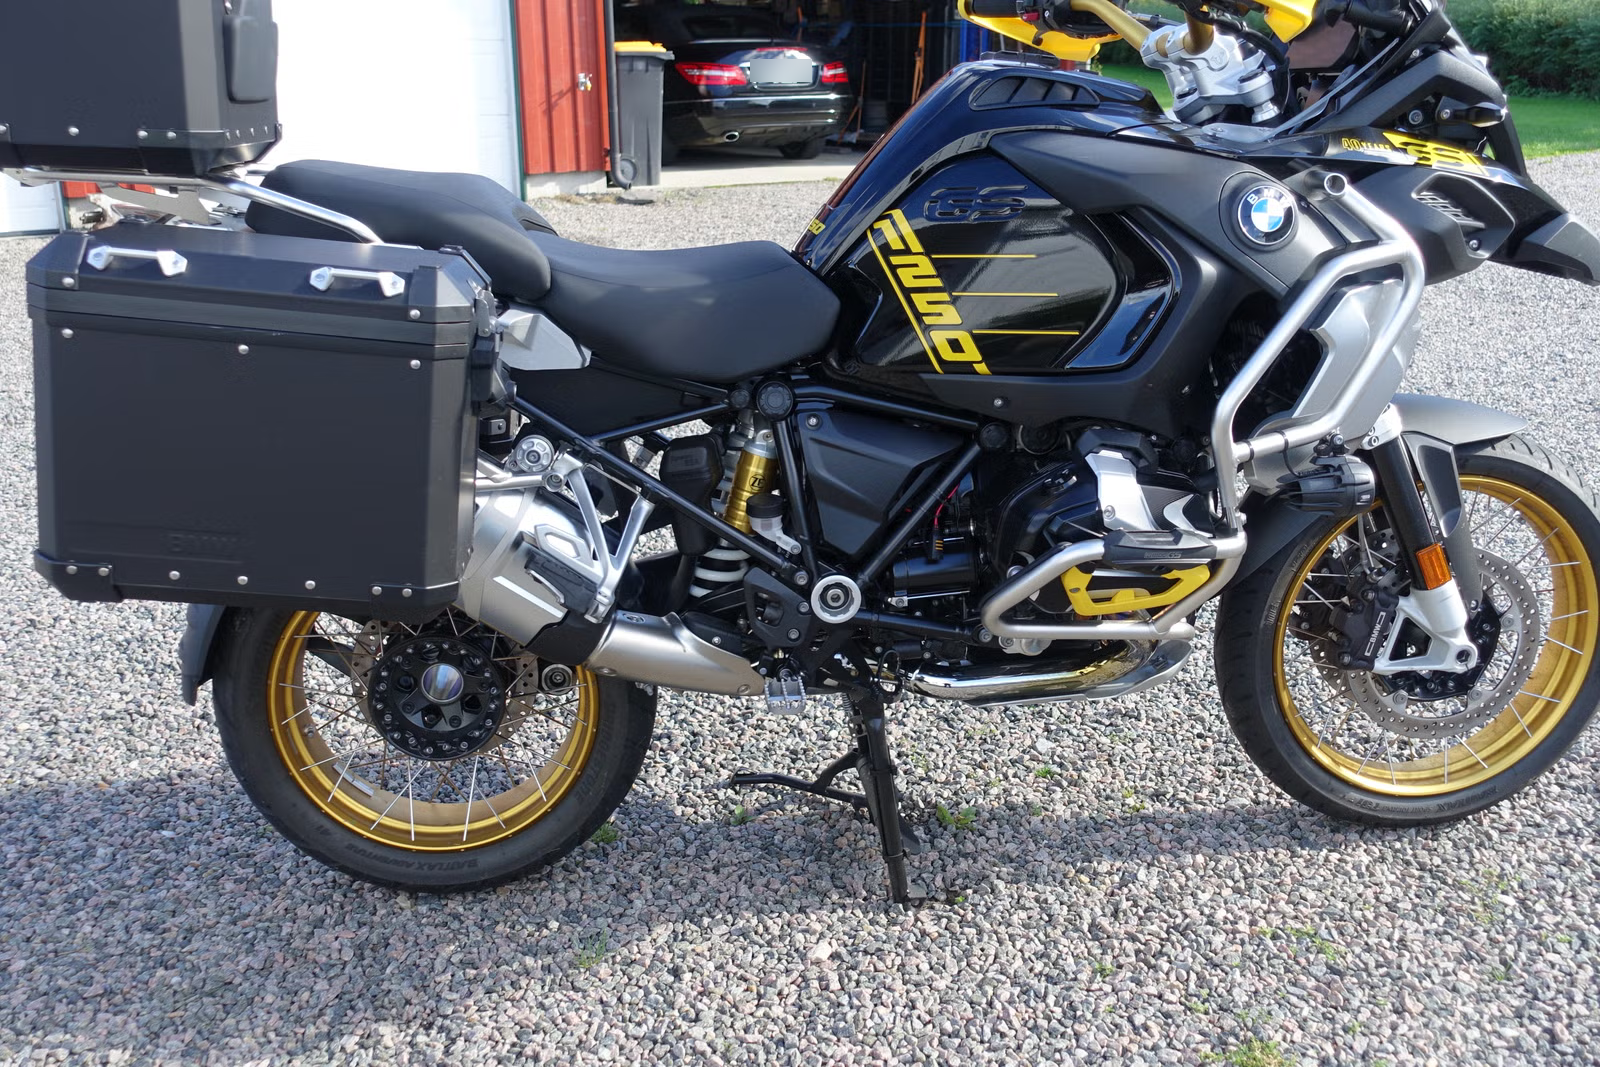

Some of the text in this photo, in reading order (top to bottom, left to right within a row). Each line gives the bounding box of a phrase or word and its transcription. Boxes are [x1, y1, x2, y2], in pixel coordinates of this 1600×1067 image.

[1341, 137, 1391, 151] 40 YEARS
[924, 184, 1028, 222] GS
[751, 477, 766, 488] ZF
[1369, 623, 1382, 643] BMW
